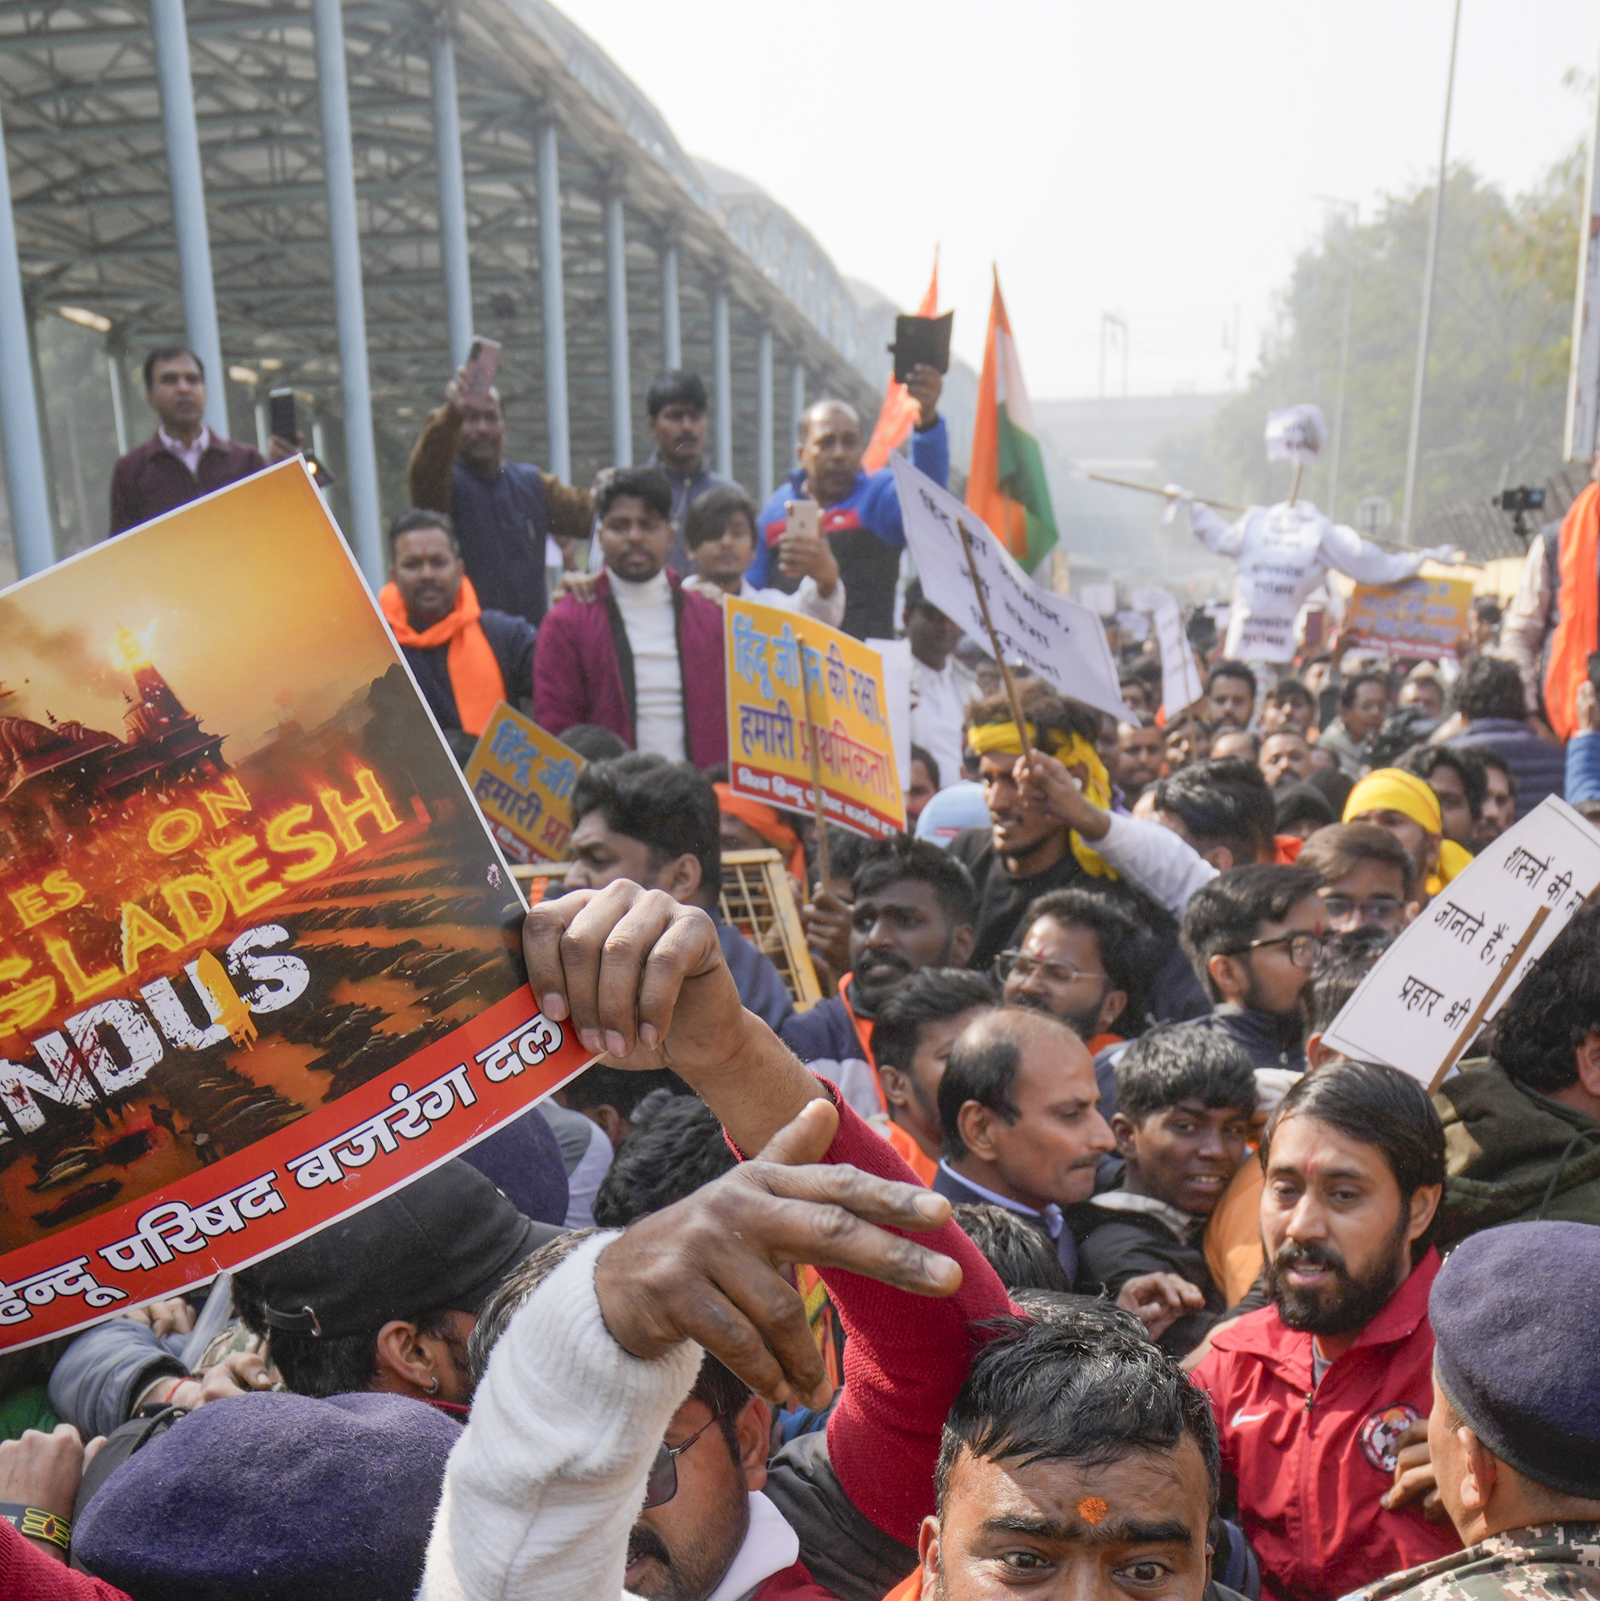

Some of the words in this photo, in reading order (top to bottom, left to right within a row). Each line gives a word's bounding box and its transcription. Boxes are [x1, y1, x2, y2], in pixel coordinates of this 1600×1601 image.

[732, 612, 775, 699] हिंदू
[825, 641, 851, 708] की
[738, 697, 795, 761] हमारी
[798, 716, 897, 802] प्रथमिकता!
[147, 775, 252, 854] ON
[475, 768, 543, 831] हमारी
[1434, 901, 1485, 944] जानते
[1398, 975, 1444, 1017] प्रहार
[1444, 997, 1471, 1030] भी
[97, 1171, 287, 1272] परिषद
[286, 1063, 479, 1190] बजरंग
[473, 1012, 564, 1084] दल
